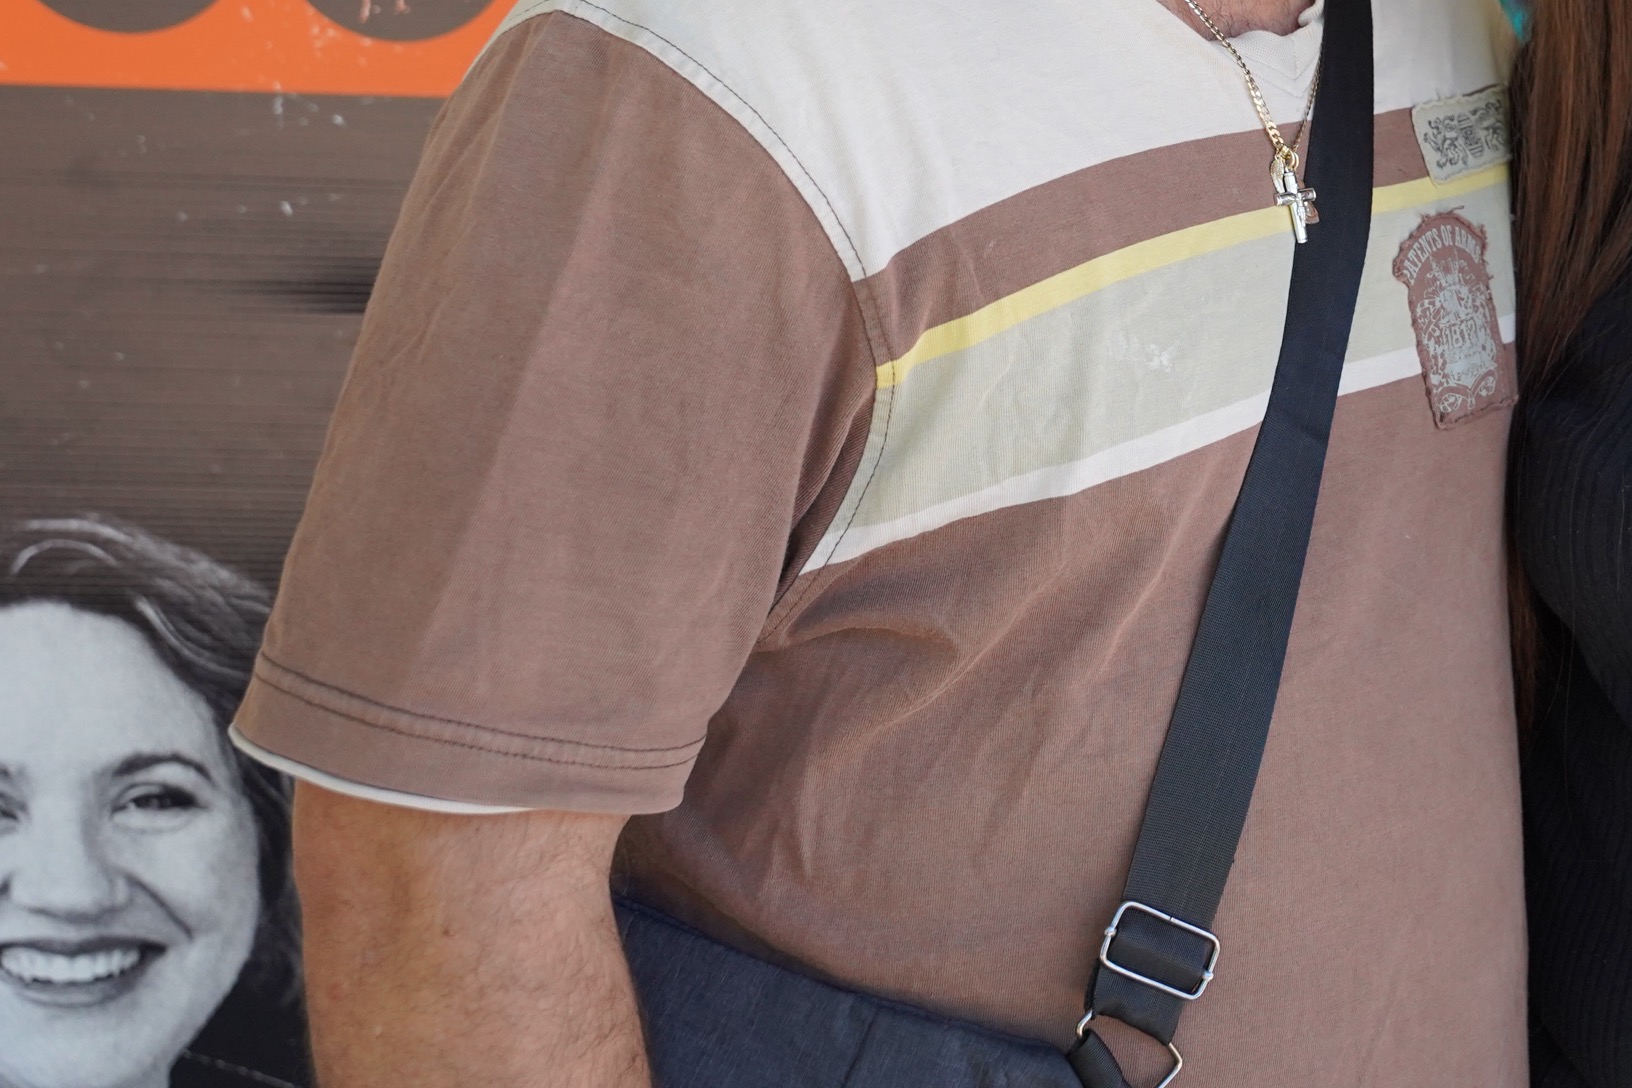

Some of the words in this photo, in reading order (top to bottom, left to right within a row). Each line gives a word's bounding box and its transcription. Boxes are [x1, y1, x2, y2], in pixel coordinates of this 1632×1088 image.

[1402, 227, 1442, 286] PATENTS
[1440, 224, 1454, 248] OF
[1454, 225, 1481, 265] ARMS
